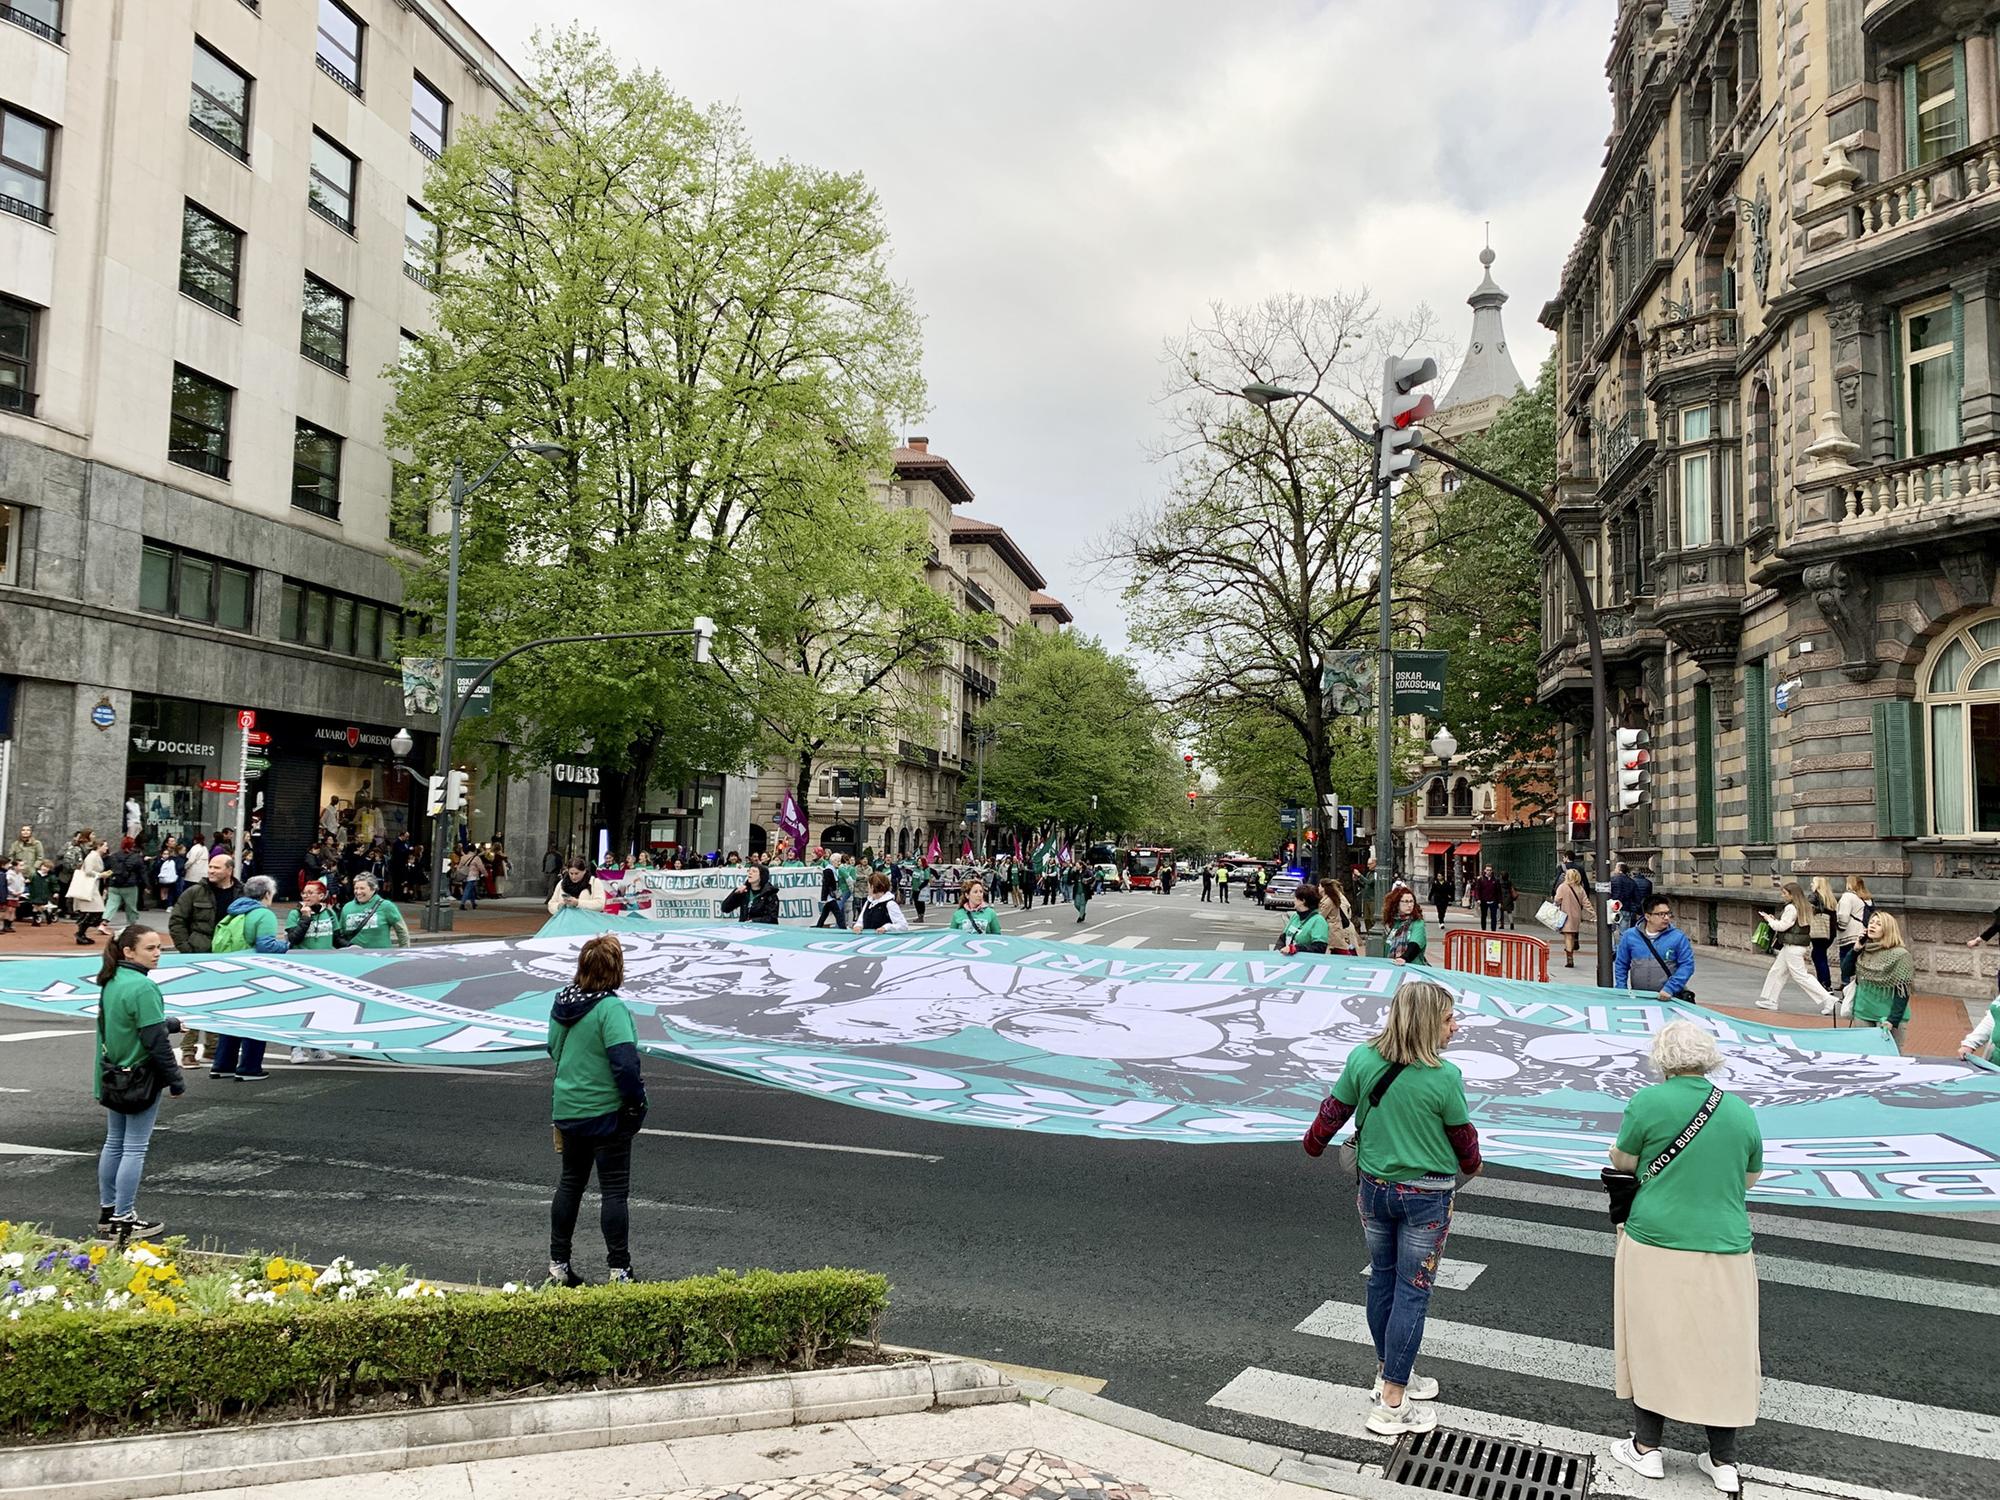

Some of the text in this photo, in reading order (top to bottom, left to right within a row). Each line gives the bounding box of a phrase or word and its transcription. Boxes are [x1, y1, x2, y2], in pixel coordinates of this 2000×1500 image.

[1395, 671, 1422, 680] OSKAR
[1395, 680, 1441, 691] KOKOSCHKA
[315, 728, 391, 747] ALVARO MORENO
[157, 740, 215, 756] DOCKERS
[554, 763, 600, 785] GUESS
[646, 875, 664, 888] GU
[667, 875, 700, 889] GABE
[702, 874, 719, 888] EZ
[720, 874, 747, 889] DAG
[656, 908, 710, 918] DE BIZKAIA
[805, 933, 1009, 958] STOP
[1675, 1111, 1708, 1149] BUENOS
[1705, 1087, 1723, 1113] AIRES
